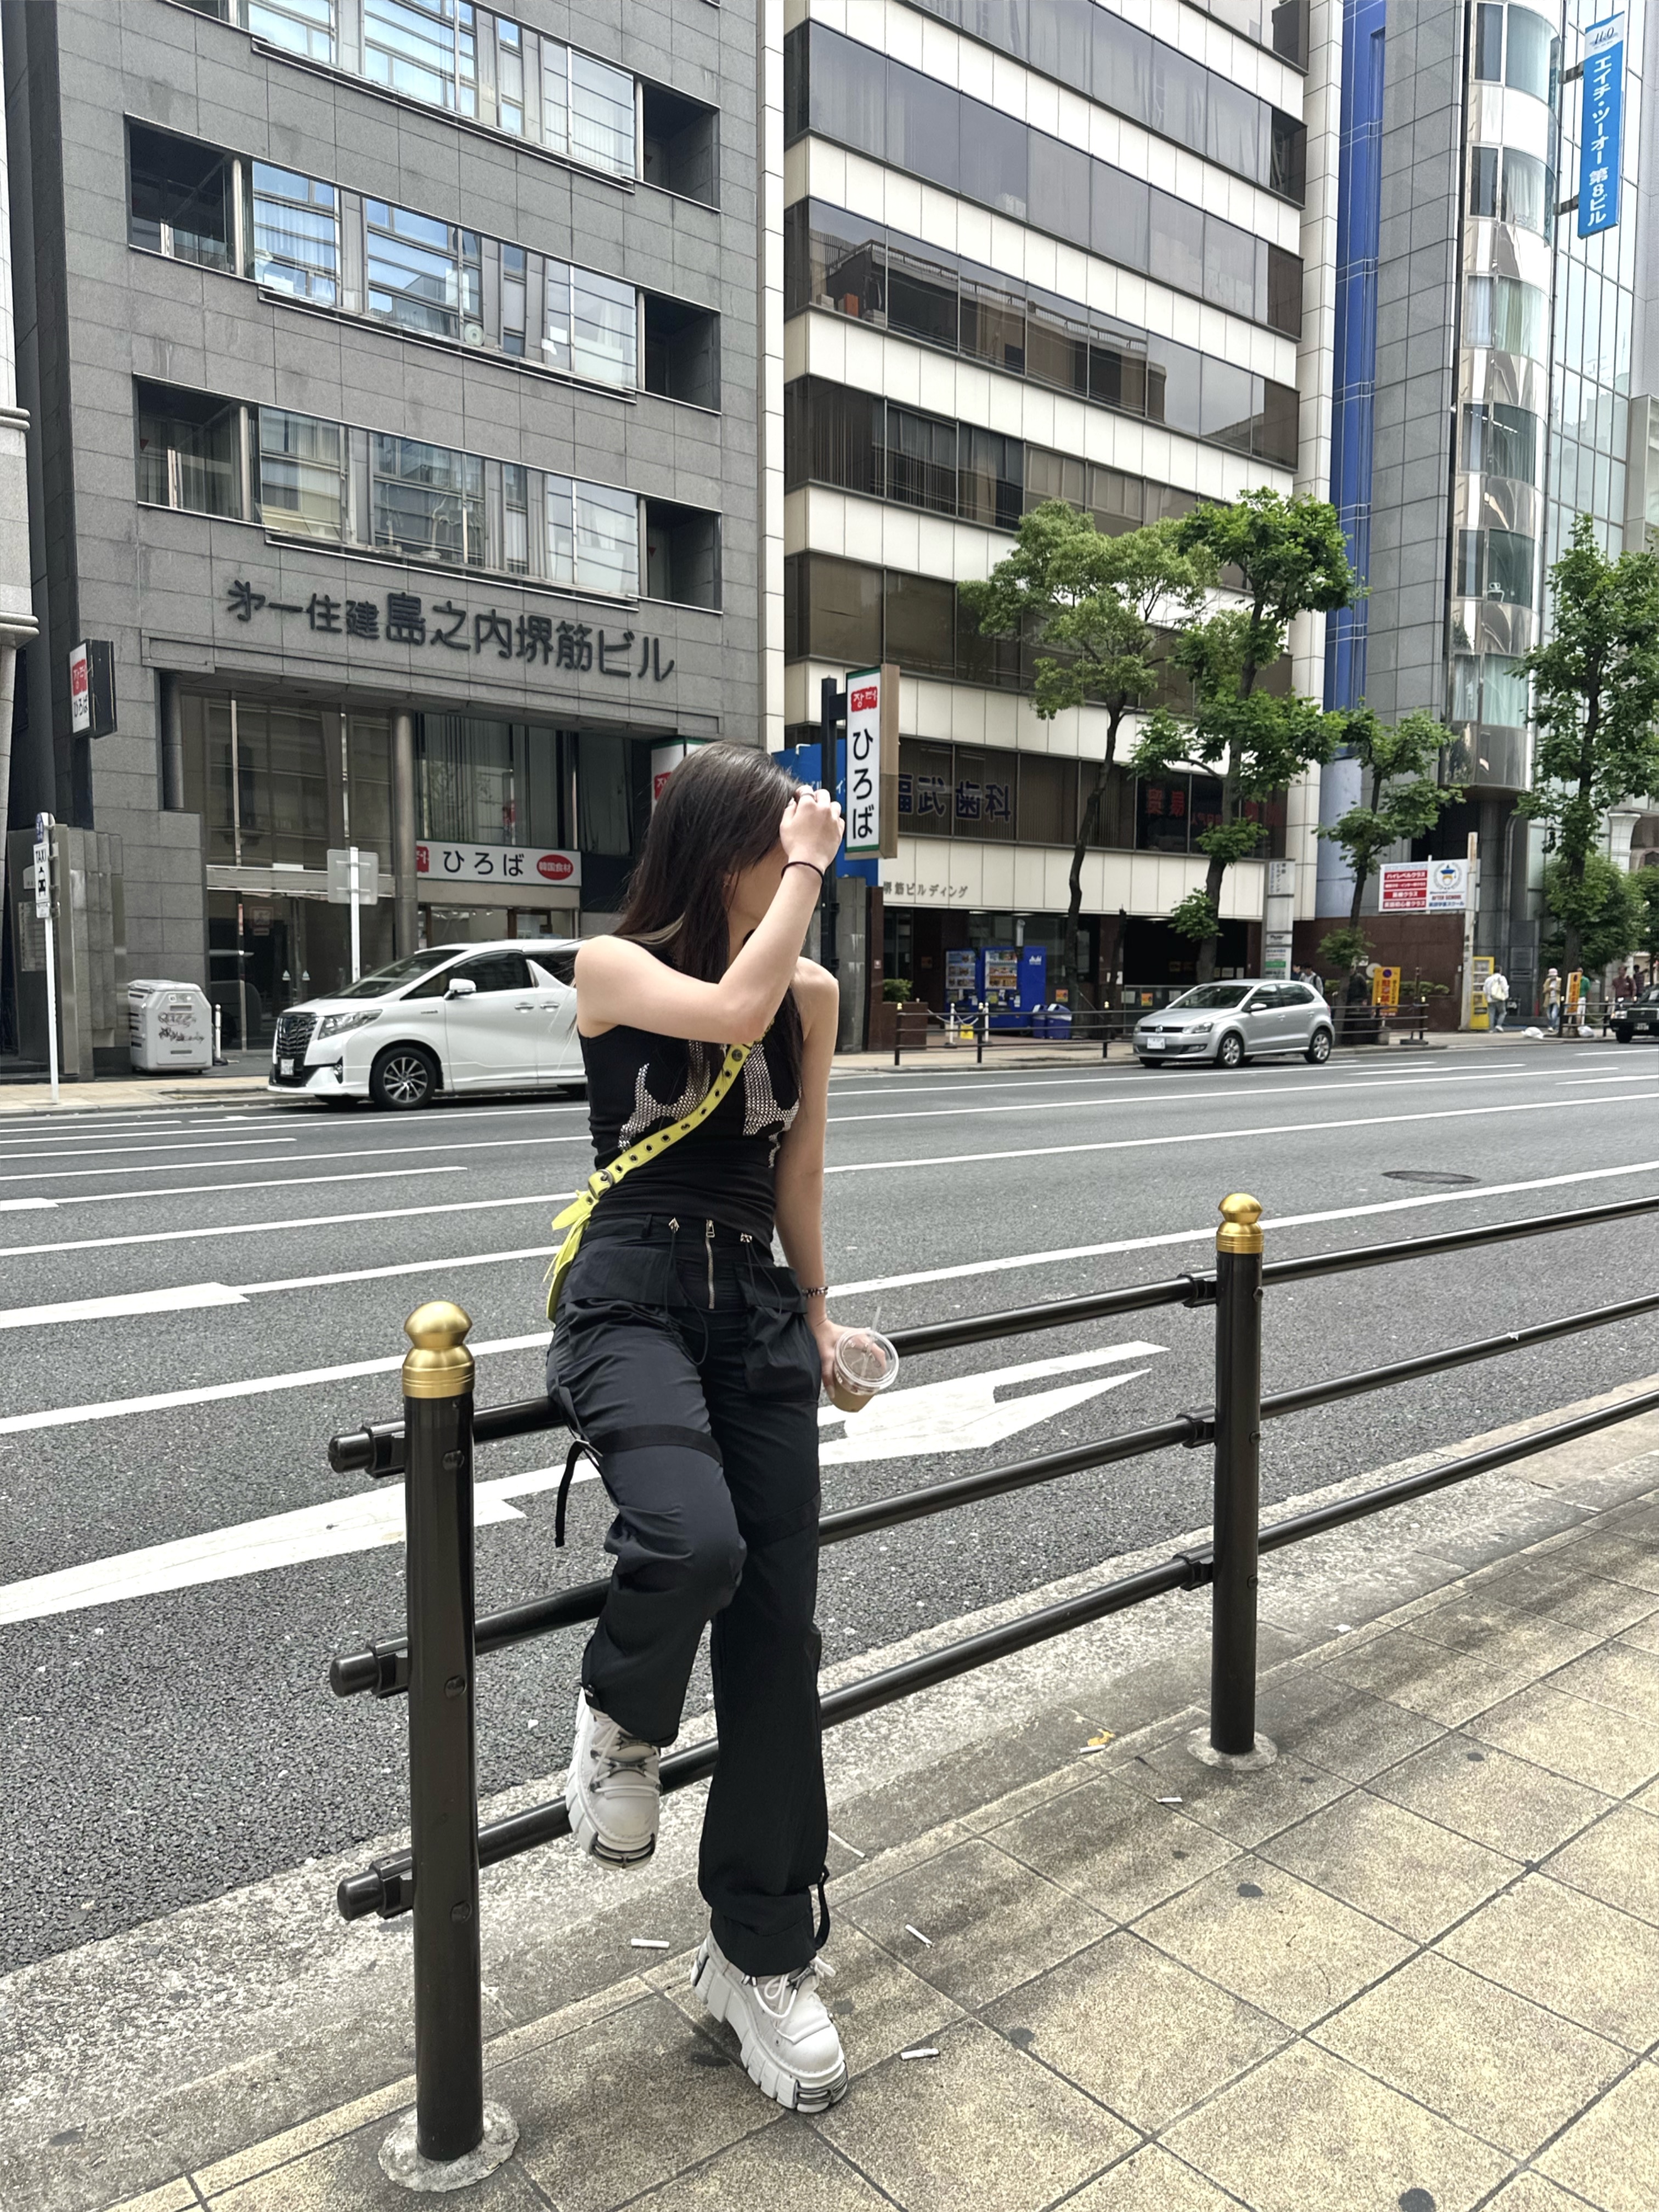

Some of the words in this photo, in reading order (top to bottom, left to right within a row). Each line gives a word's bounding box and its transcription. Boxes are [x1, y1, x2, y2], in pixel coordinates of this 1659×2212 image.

[74, 695, 88, 718] ひろば
[853, 690, 878, 708] 장터
[853, 728, 874, 840] ひろば
[36, 851, 47, 864] TAXI
[443, 850, 525, 877] ひろば
